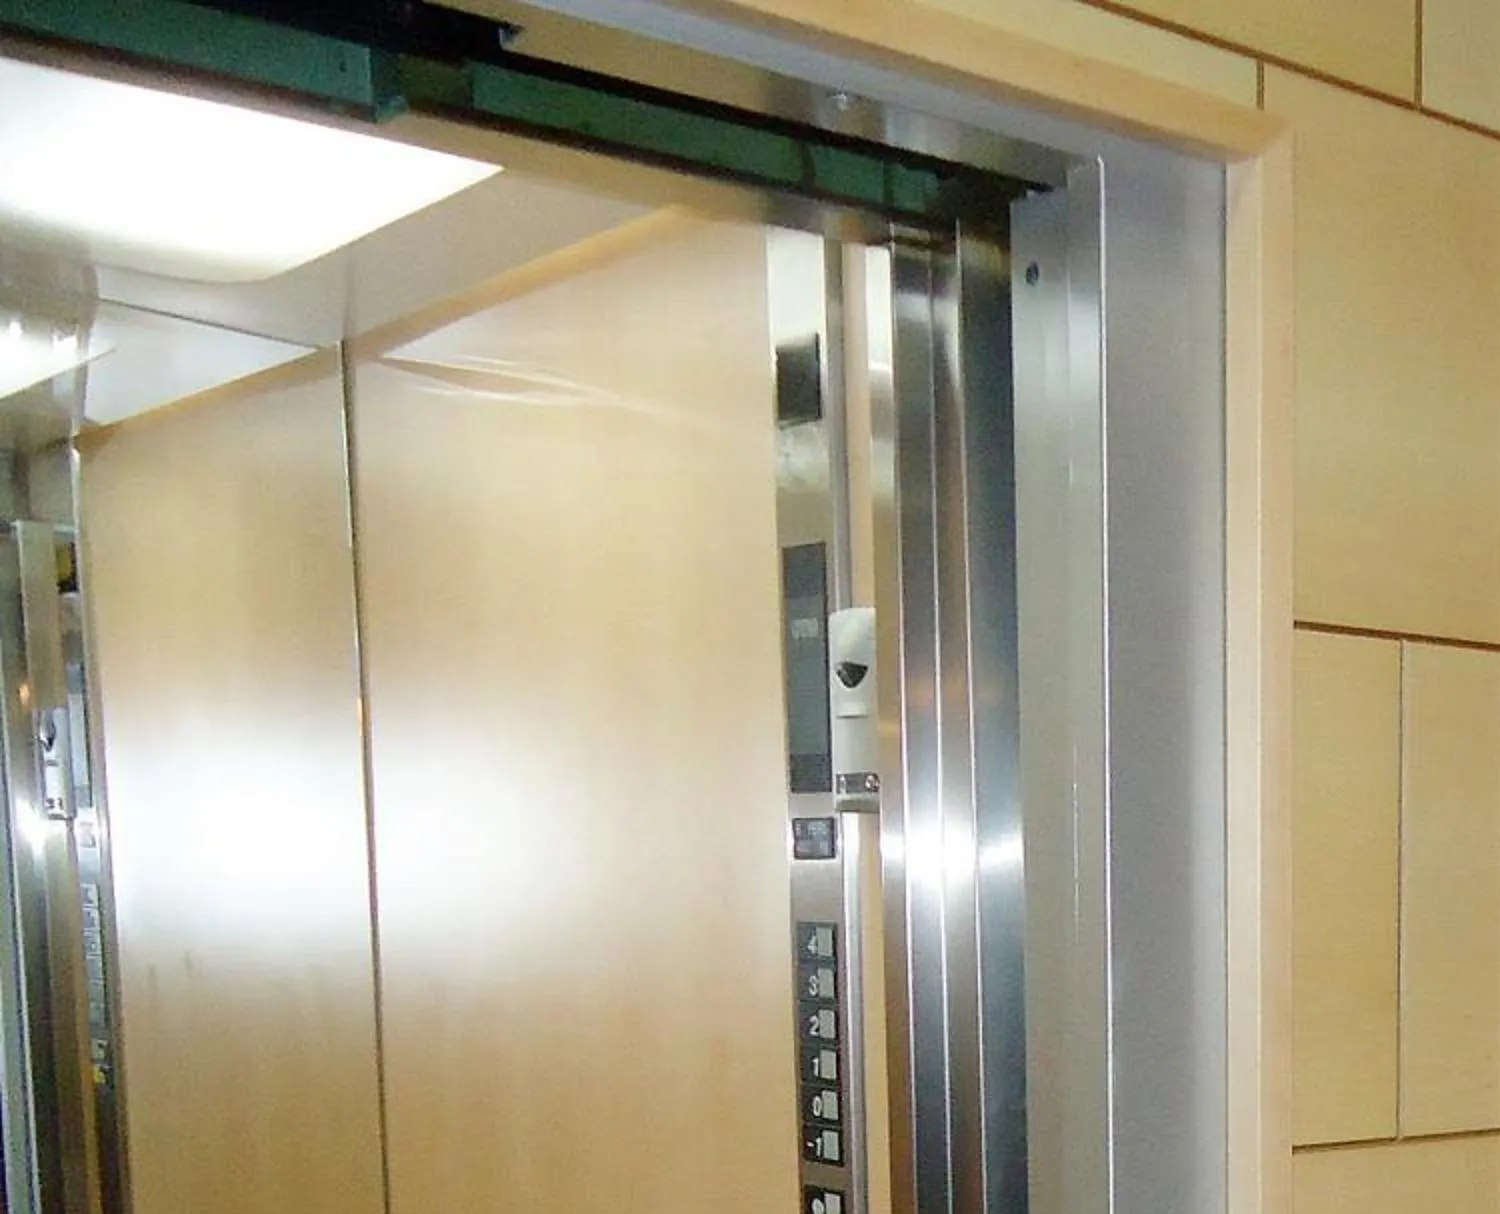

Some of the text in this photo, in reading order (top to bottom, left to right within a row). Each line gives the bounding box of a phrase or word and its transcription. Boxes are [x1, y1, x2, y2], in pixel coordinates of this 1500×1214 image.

[808, 975, 818, 996] 3
[809, 1015, 820, 1036] 2
[812, 1057, 819, 1077] 1
[812, 1095, 822, 1117] 0
[806, 1137, 822, 1158] -1
